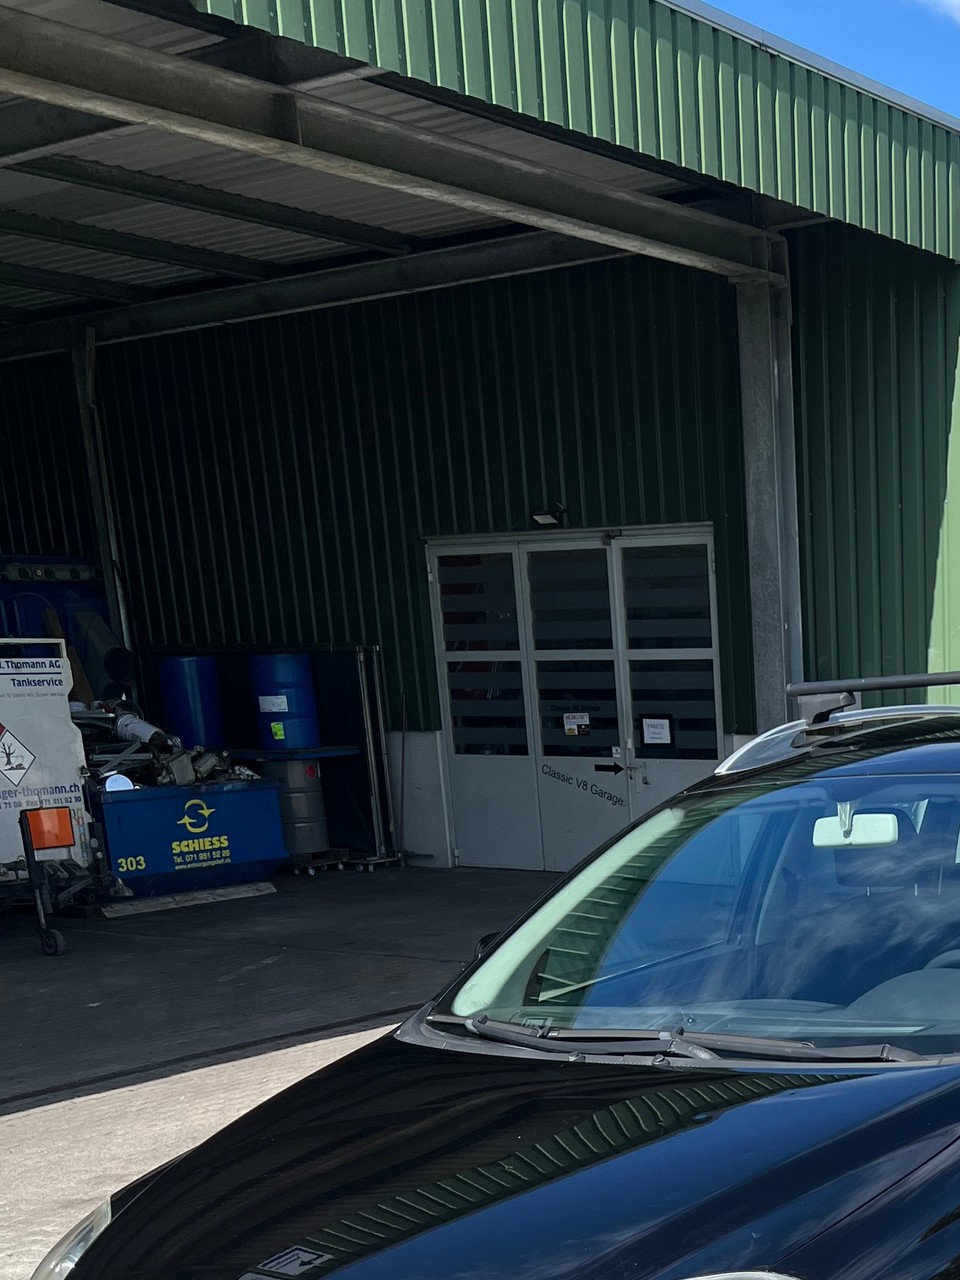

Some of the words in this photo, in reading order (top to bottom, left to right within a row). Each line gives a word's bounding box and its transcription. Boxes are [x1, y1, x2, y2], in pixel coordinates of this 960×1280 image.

[5, 660, 46, 669] Thomann
[49, 660, 61, 669] AG
[11, 677, 63, 687] Tankservice
[0, 783, 80, 800] ger-thomann.ch
[541, 764, 573, 785] Classic
[575, 777, 588, 791] V8
[590, 784, 624, 806] Garage
[172, 835, 229, 853] SCHIESS
[117, 855, 146, 872] 303
